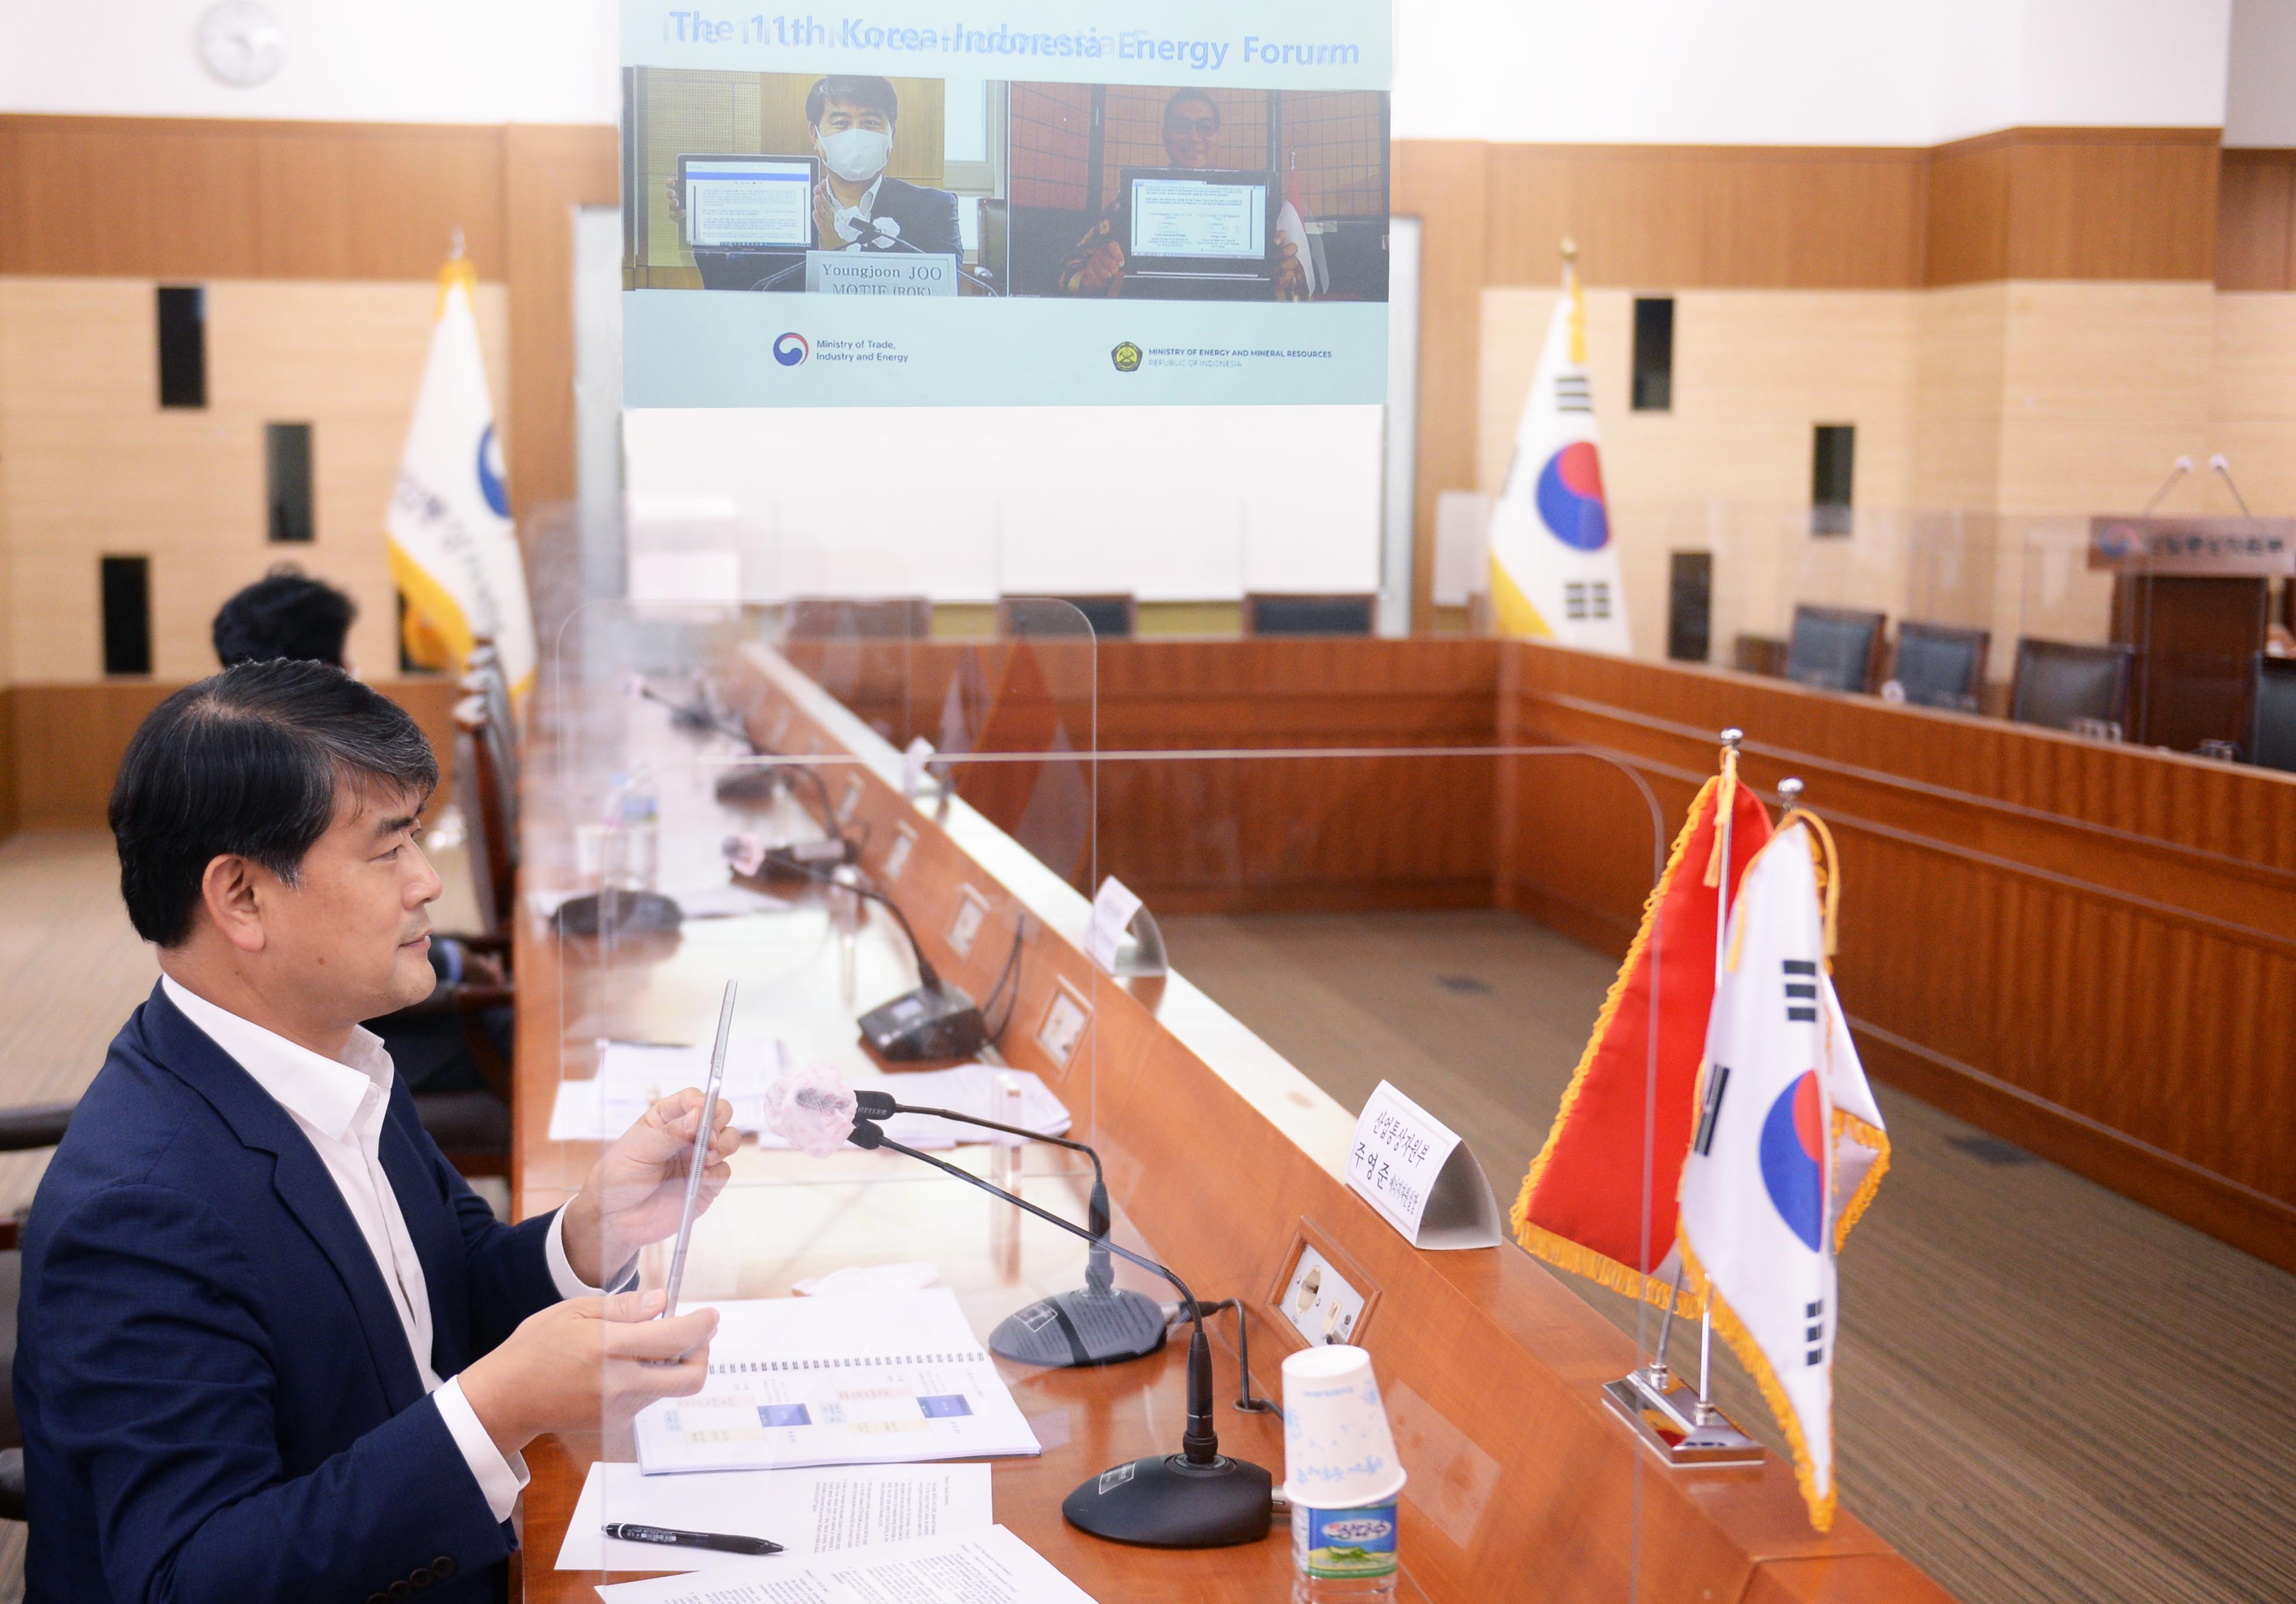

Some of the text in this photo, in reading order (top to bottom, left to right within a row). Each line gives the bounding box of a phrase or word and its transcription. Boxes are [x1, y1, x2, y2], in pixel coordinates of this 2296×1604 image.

[668, 11, 734, 44] The
[750, 15, 825, 47] 11th
[1119, 31, 1229, 70] Energy
[822, 263, 942, 280] Youngjoon JOO
[816, 340, 853, 350] Ministry
[816, 353, 854, 362] Industry
[877, 353, 908, 363] Energy
[1373, 1111, 1430, 1168] 산업통상자원부
[1354, 1141, 1390, 1190] 주영준
